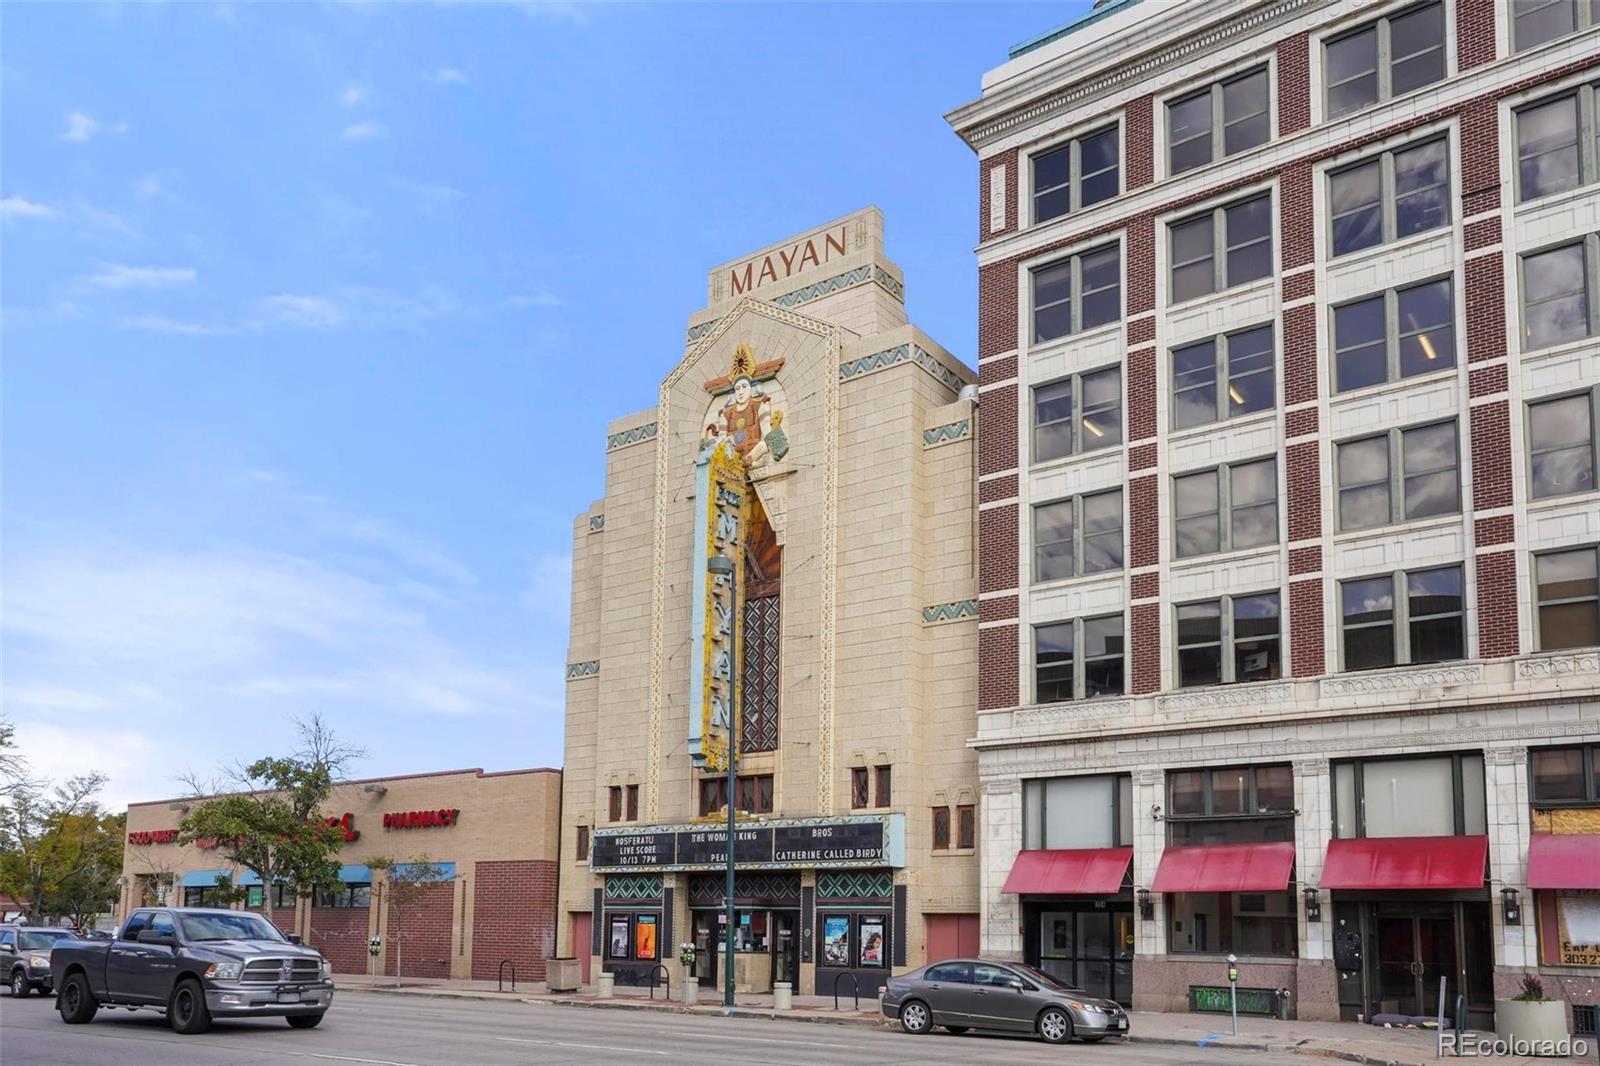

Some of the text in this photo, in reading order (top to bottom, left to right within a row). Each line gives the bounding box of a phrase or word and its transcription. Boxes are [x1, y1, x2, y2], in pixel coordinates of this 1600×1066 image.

[731, 226, 846, 297] MAYAN
[383, 808, 460, 830] PHARMACY
[692, 834, 704, 843] THE
[739, 831, 757, 841] KING
[812, 828, 832, 838] BROS
[615, 835, 654, 846] NOSFERATU
[620, 845, 656, 855] LIVE SCORE
[776, 848, 882, 860] CATHERINE CALLED BIRDY
[620, 855, 657, 865] 10/13 7PM
